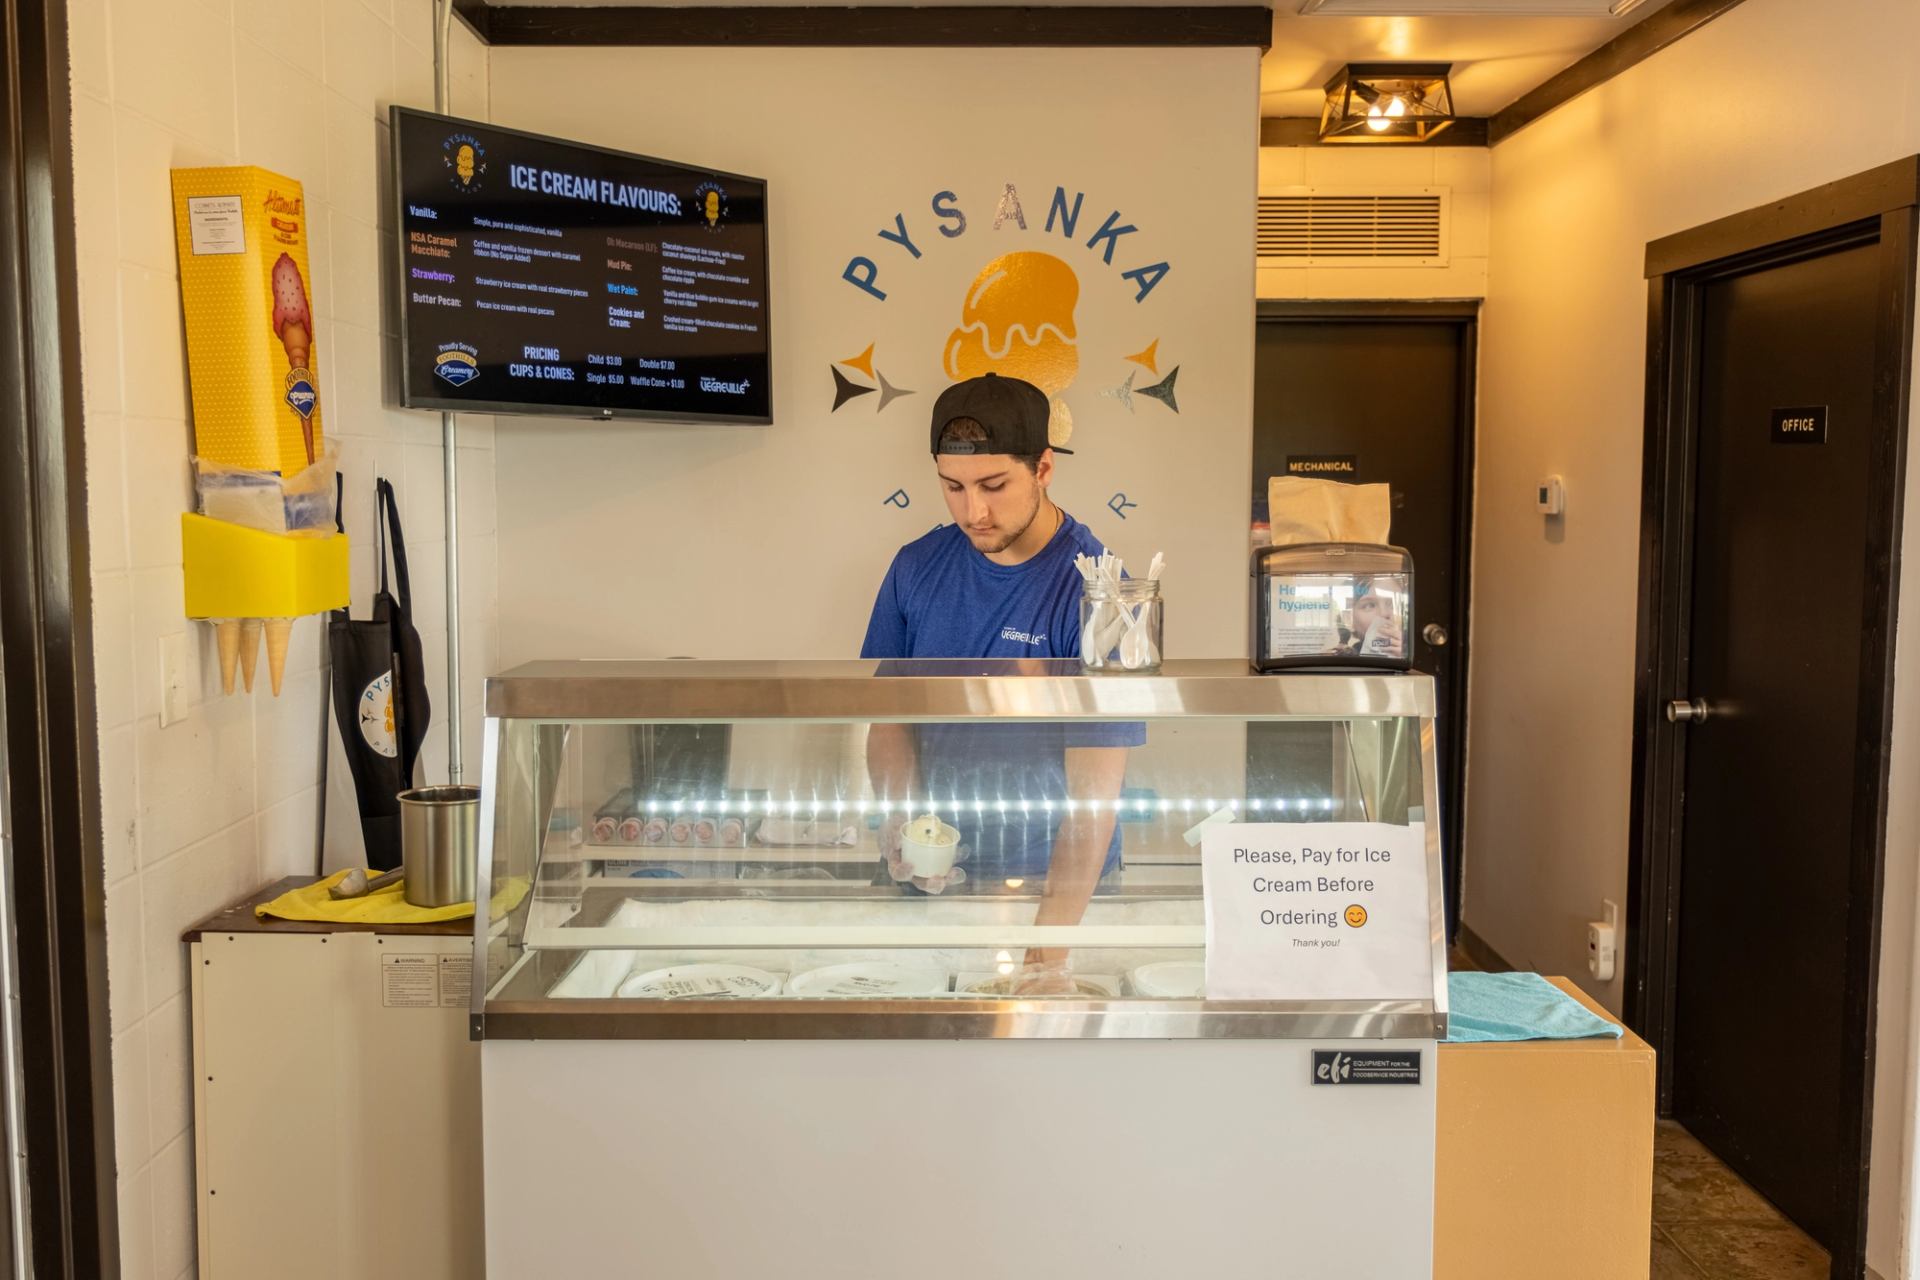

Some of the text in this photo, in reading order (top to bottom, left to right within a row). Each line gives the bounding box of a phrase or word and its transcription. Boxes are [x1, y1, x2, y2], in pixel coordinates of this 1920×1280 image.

[511, 164, 538, 192] ICE
[541, 171, 598, 202] CREAM
[601, 181, 682, 216] FLAVOURS:
[409, 205, 438, 219] Vanilla:
[411, 231, 458, 248] NSA Caramel
[842, 183, 1171, 304] PYSANKA
[411, 244, 451, 258] Macchiato:
[607, 259, 632, 271] Mud Pie:
[411, 268, 456, 284] Strawberry:
[475, 276, 503, 288] Strawberry
[503, 280, 511, 288] ice
[511, 282, 527, 290] cream
[527, 283, 538, 291] with
[538, 284, 548, 293] real
[548, 285, 574, 296] strawberry
[607, 283, 639, 297] Wet Paint:
[413, 293, 462, 308] Butter Pecan:
[476, 300, 492, 309] Pecan
[492, 302, 500, 310] ice
[500, 304, 516, 312] cream
[516, 305, 528, 313] with
[528, 306, 538, 314] real
[608, 306, 645, 319] Cookies and
[608, 317, 631, 328] Cream:
[459, 342, 478, 356] Serving
[524, 346, 560, 362] PRICING
[587, 354, 623, 367] Child $3.00
[639, 358, 676, 371] Double $7.00
[510, 363, 575, 381] CUPS & CONES:
[586, 372, 625, 386] Single $5.00
[630, 376, 649, 387] Waffle
[650, 377, 666, 388] Cone
[671, 379, 685, 389] $1.00
[700, 380, 746, 394] VEGREVILLE
[1782, 418, 1815, 432] OFFICE
[1289, 462, 1354, 472] MECHANICAL
[1278, 599, 1330, 612] hygiene
[1233, 848, 1391, 866] Please, Pay for Ice
[1253, 877, 1375, 893] Cream Before
[1260, 909, 1338, 928] Ordering
[1292, 938, 1341, 949] Thank you!
